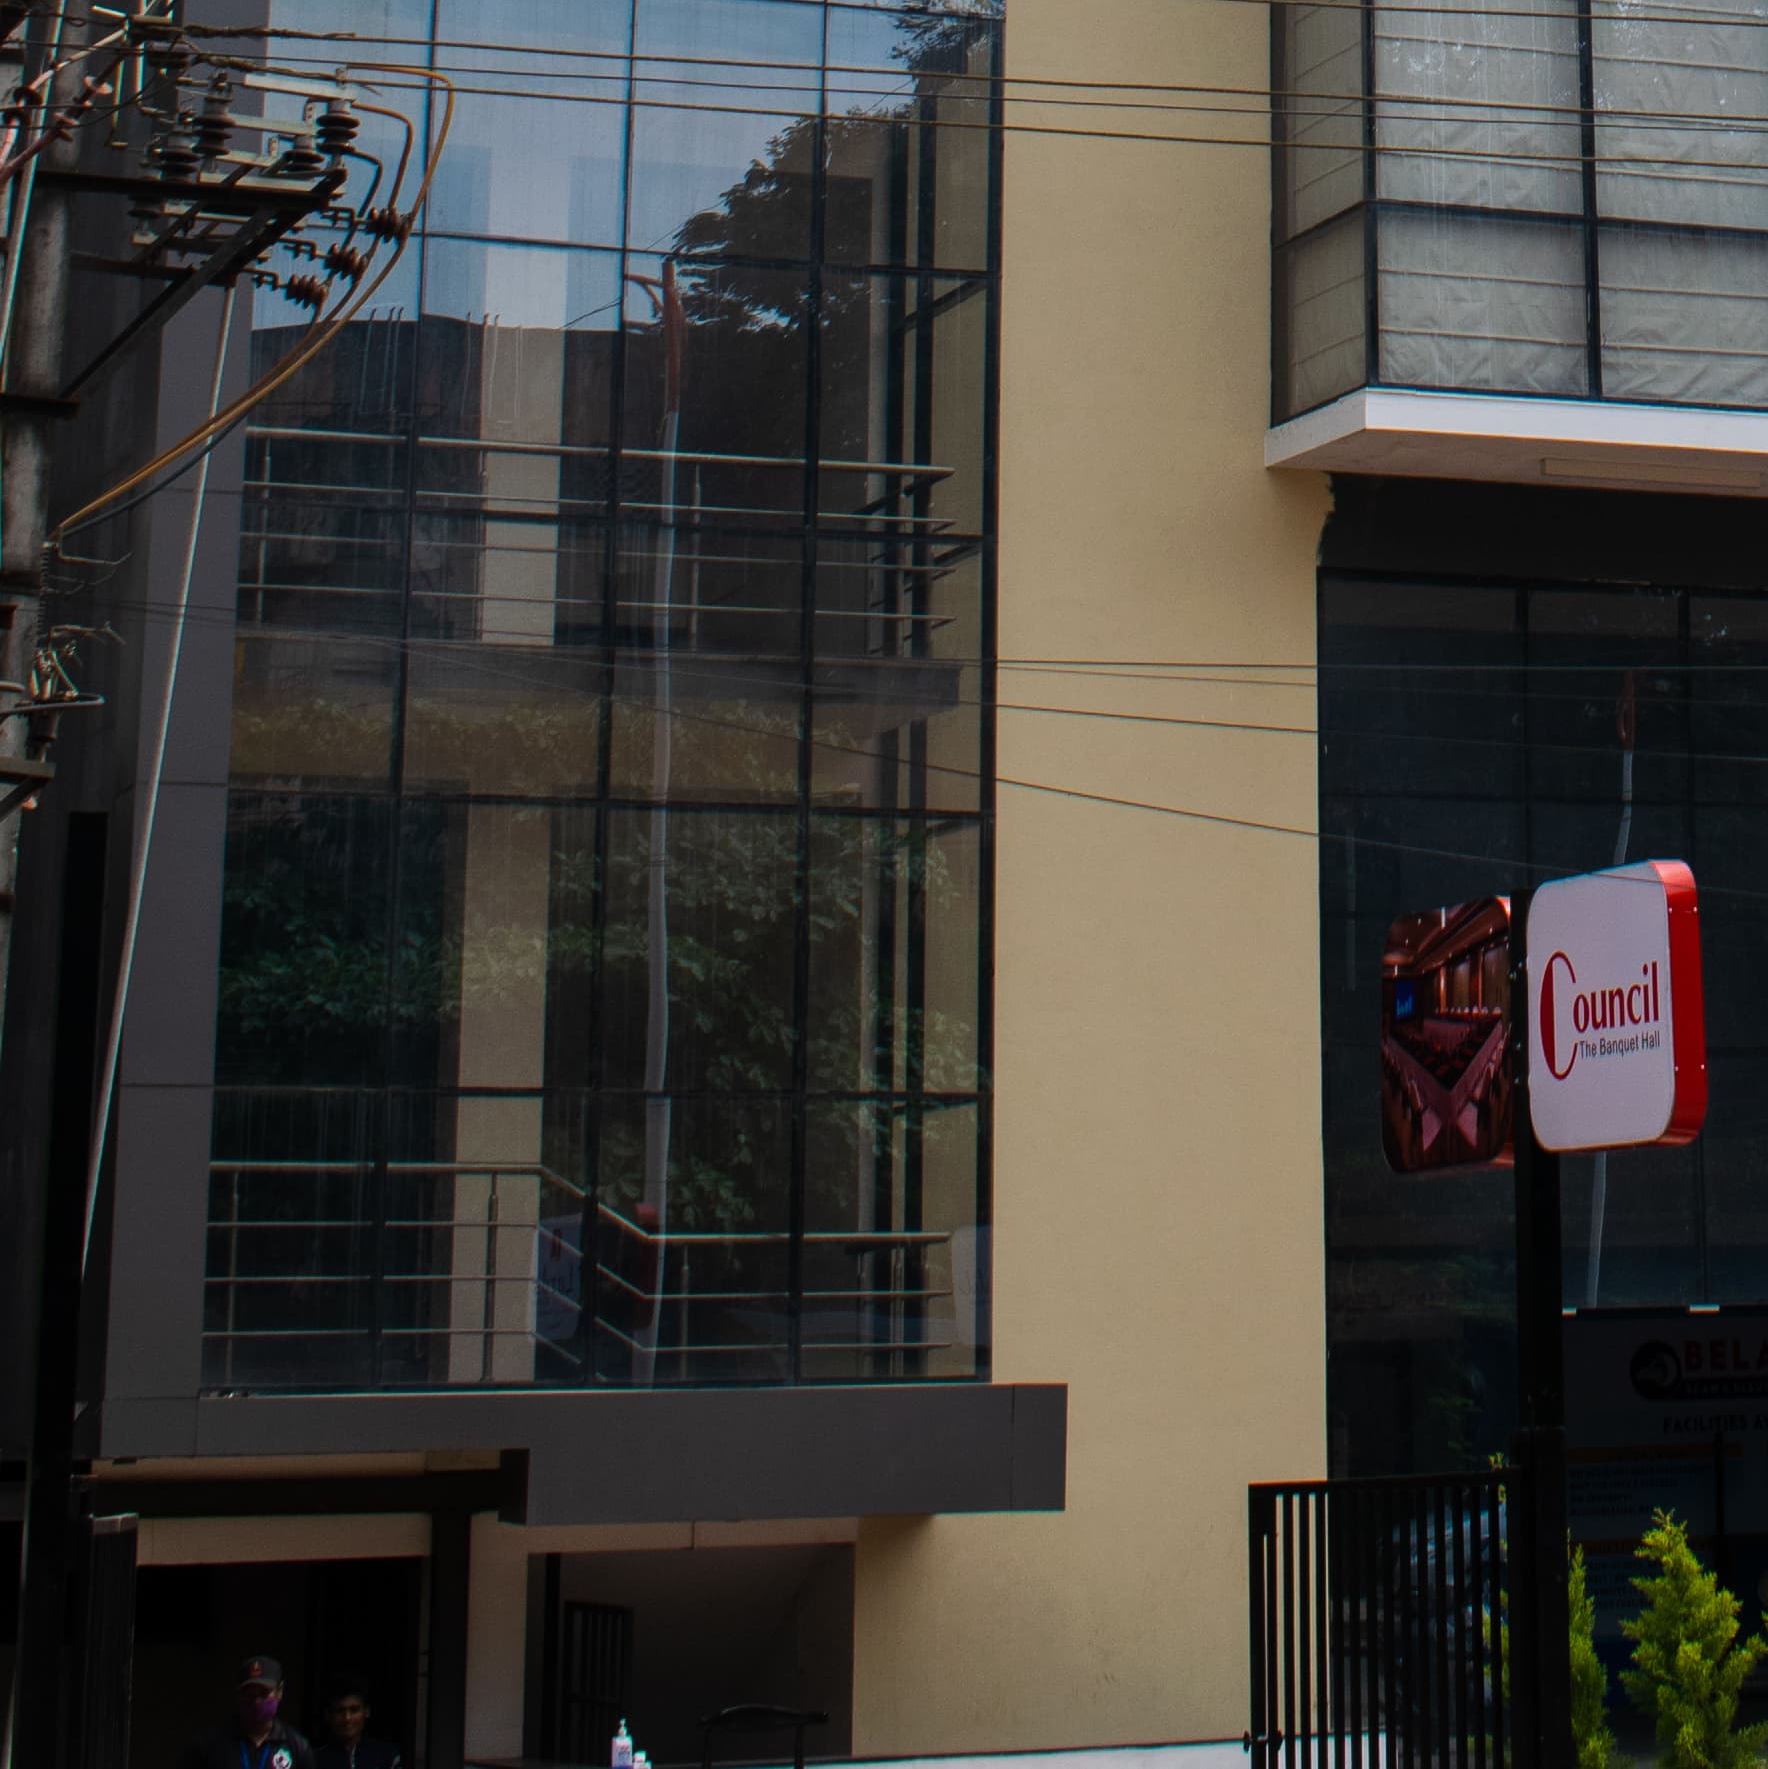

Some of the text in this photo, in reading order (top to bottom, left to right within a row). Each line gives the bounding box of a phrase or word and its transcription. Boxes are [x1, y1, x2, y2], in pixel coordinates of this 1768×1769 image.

[1540, 951, 1660, 1080] Council
[1579, 1032, 1661, 1059] The Banquet Hall
